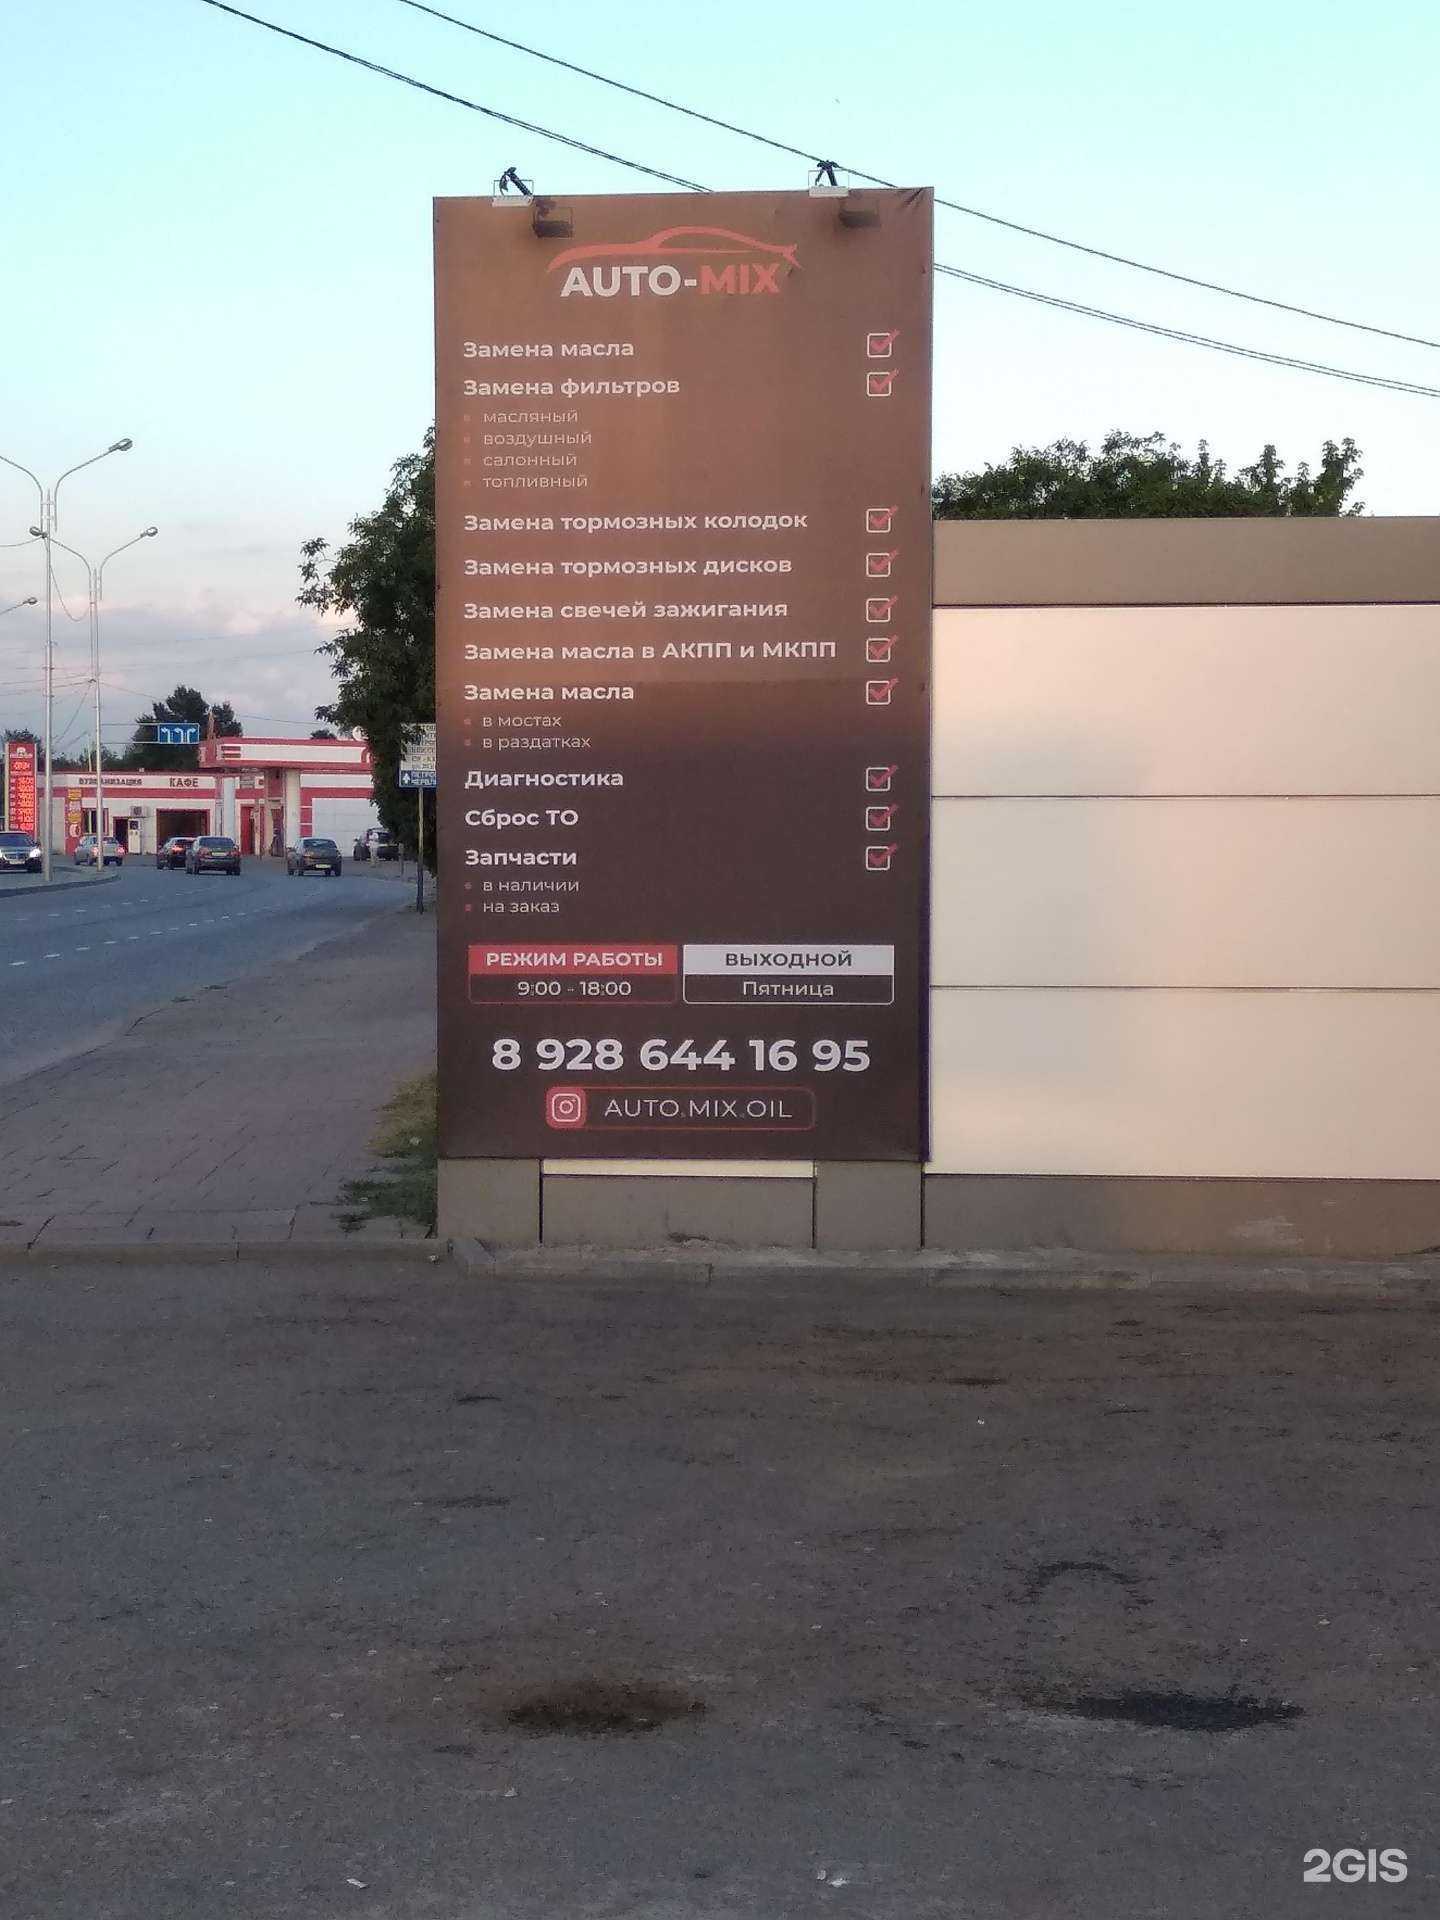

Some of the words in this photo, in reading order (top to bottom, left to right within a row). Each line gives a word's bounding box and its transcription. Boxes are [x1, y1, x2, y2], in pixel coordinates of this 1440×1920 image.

[561, 264, 781, 297] AUTO-MIX
[463, 342, 553, 357] Замена
[561, 341, 634, 356] масла
[463, 380, 553, 395] Замена
[561, 378, 680, 398] фильтров
[483, 409, 578, 423] масляный
[483, 431, 592, 447] воздушный
[483, 453, 577, 466] салонный
[483, 474, 588, 488] топливный
[464, 515, 554, 530] Замена
[561, 515, 697, 533] тормозных
[705, 513, 807, 531] колодок
[464, 560, 554, 575] Замена
[561, 559, 696, 578] тормозных
[703, 558, 792, 576] дисков
[464, 604, 553, 619] Замена
[561, 600, 646, 618] свечей
[654, 602, 787, 619] зажигания
[464, 645, 554, 660] Замена
[561, 645, 634, 659] масла
[642, 645, 654, 659] в
[662, 643, 732, 659] АКПП
[740, 645, 754, 658] и
[763, 641, 836, 658] МКПП
[464, 685, 554, 700] Замена
[561, 685, 634, 700] масла
[483, 716, 492, 727] в
[498, 716, 561, 727] мостах
[483, 737, 492, 748] в
[499, 736, 591, 751] раздатках
[169, 777, 198, 788] КАФЕ
[465, 771, 624, 789] Диагностика
[465, 809, 539, 828] Сброс
[546, 809, 579, 826] ТО
[465, 850, 577, 866] Запчасти
[483, 880, 492, 891] в
[499, 880, 579, 891] наличии
[483, 901, 505, 913] на
[510, 901, 560, 913] заказ
[486, 952, 566, 967] РЕЖИМ
[573, 951, 663, 967] РАБОТЫ
[725, 950, 852, 970] ВЫХОДНОЙ
[517, 981, 561, 996] 9:00
[580, 981, 631, 996] 18:00
[743, 981, 834, 998] Пятница
[492, 1039, 521, 1071] 8
[536, 1038, 624, 1071] 928
[640, 1039, 736, 1072] 644
[749, 1038, 797, 1072] 16
[812, 1039, 871, 1072] 95
